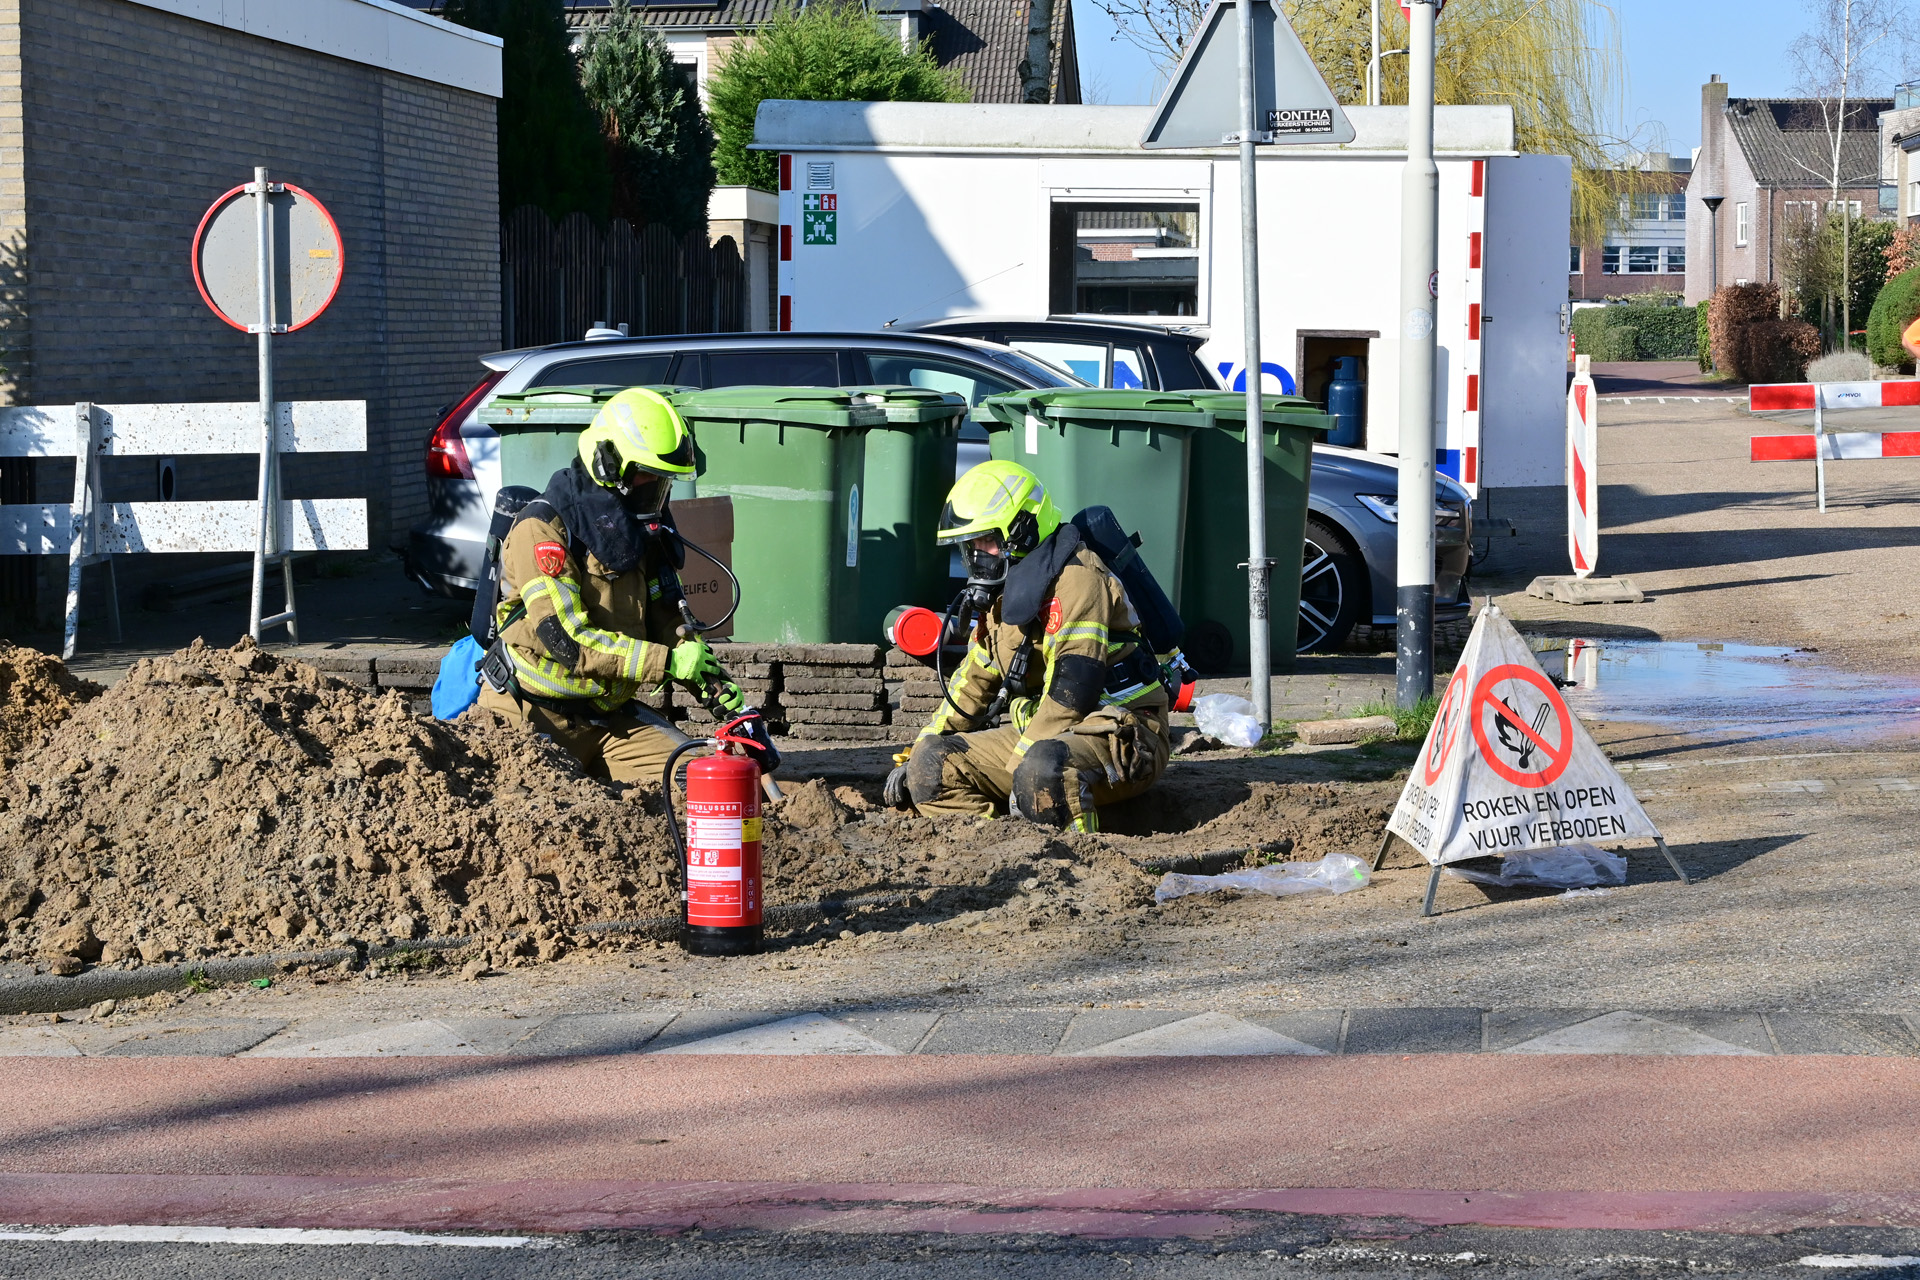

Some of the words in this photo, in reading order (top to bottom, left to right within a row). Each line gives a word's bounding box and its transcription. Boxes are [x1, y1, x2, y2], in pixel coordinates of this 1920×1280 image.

[1269, 110, 1330, 121] MONTHA
[682, 583, 707, 595] ELIFE
[1463, 794, 1530, 822] ROKEN
[1534, 791, 1560, 813] EN
[1565, 786, 1617, 810] OPEN
[1469, 825, 1522, 851] VUUR
[1526, 815, 1626, 845] VERBODEN
